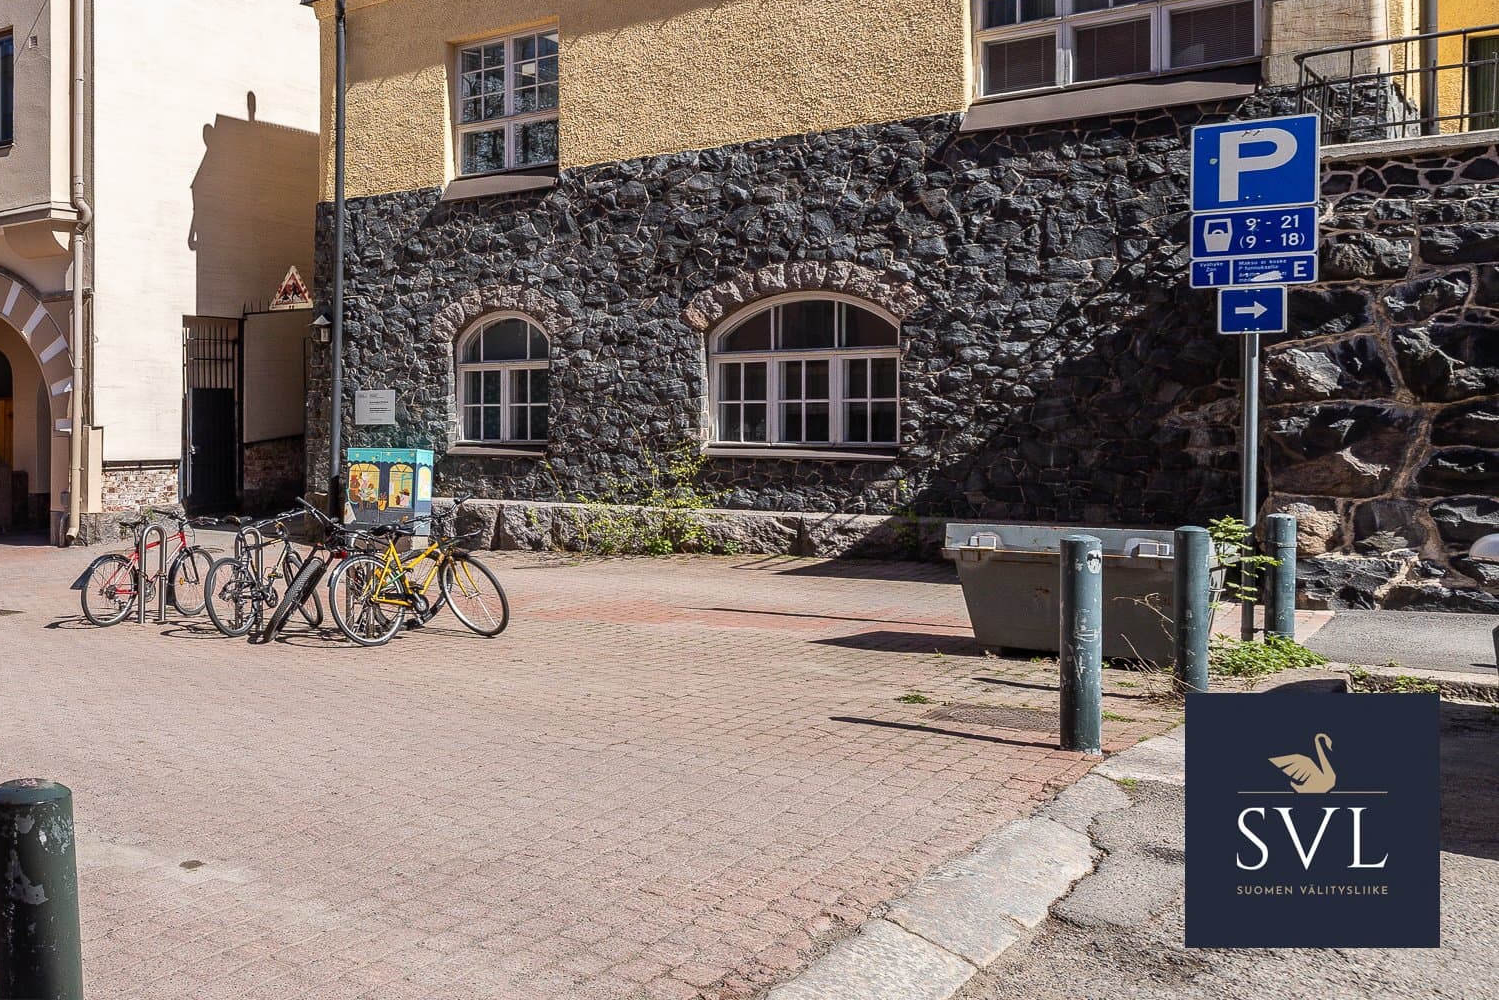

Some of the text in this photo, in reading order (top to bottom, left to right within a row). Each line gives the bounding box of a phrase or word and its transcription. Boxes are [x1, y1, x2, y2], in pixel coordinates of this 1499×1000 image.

[1219, 127, 1298, 202] P
[1245, 217, 1257, 231] 9
[1280, 214, 1299, 229] 21
[1240, 235, 1257, 249] (9
[1280, 232, 1305, 247] 18)
[1293, 260, 1308, 277] E
[1207, 272, 1214, 285] 1
